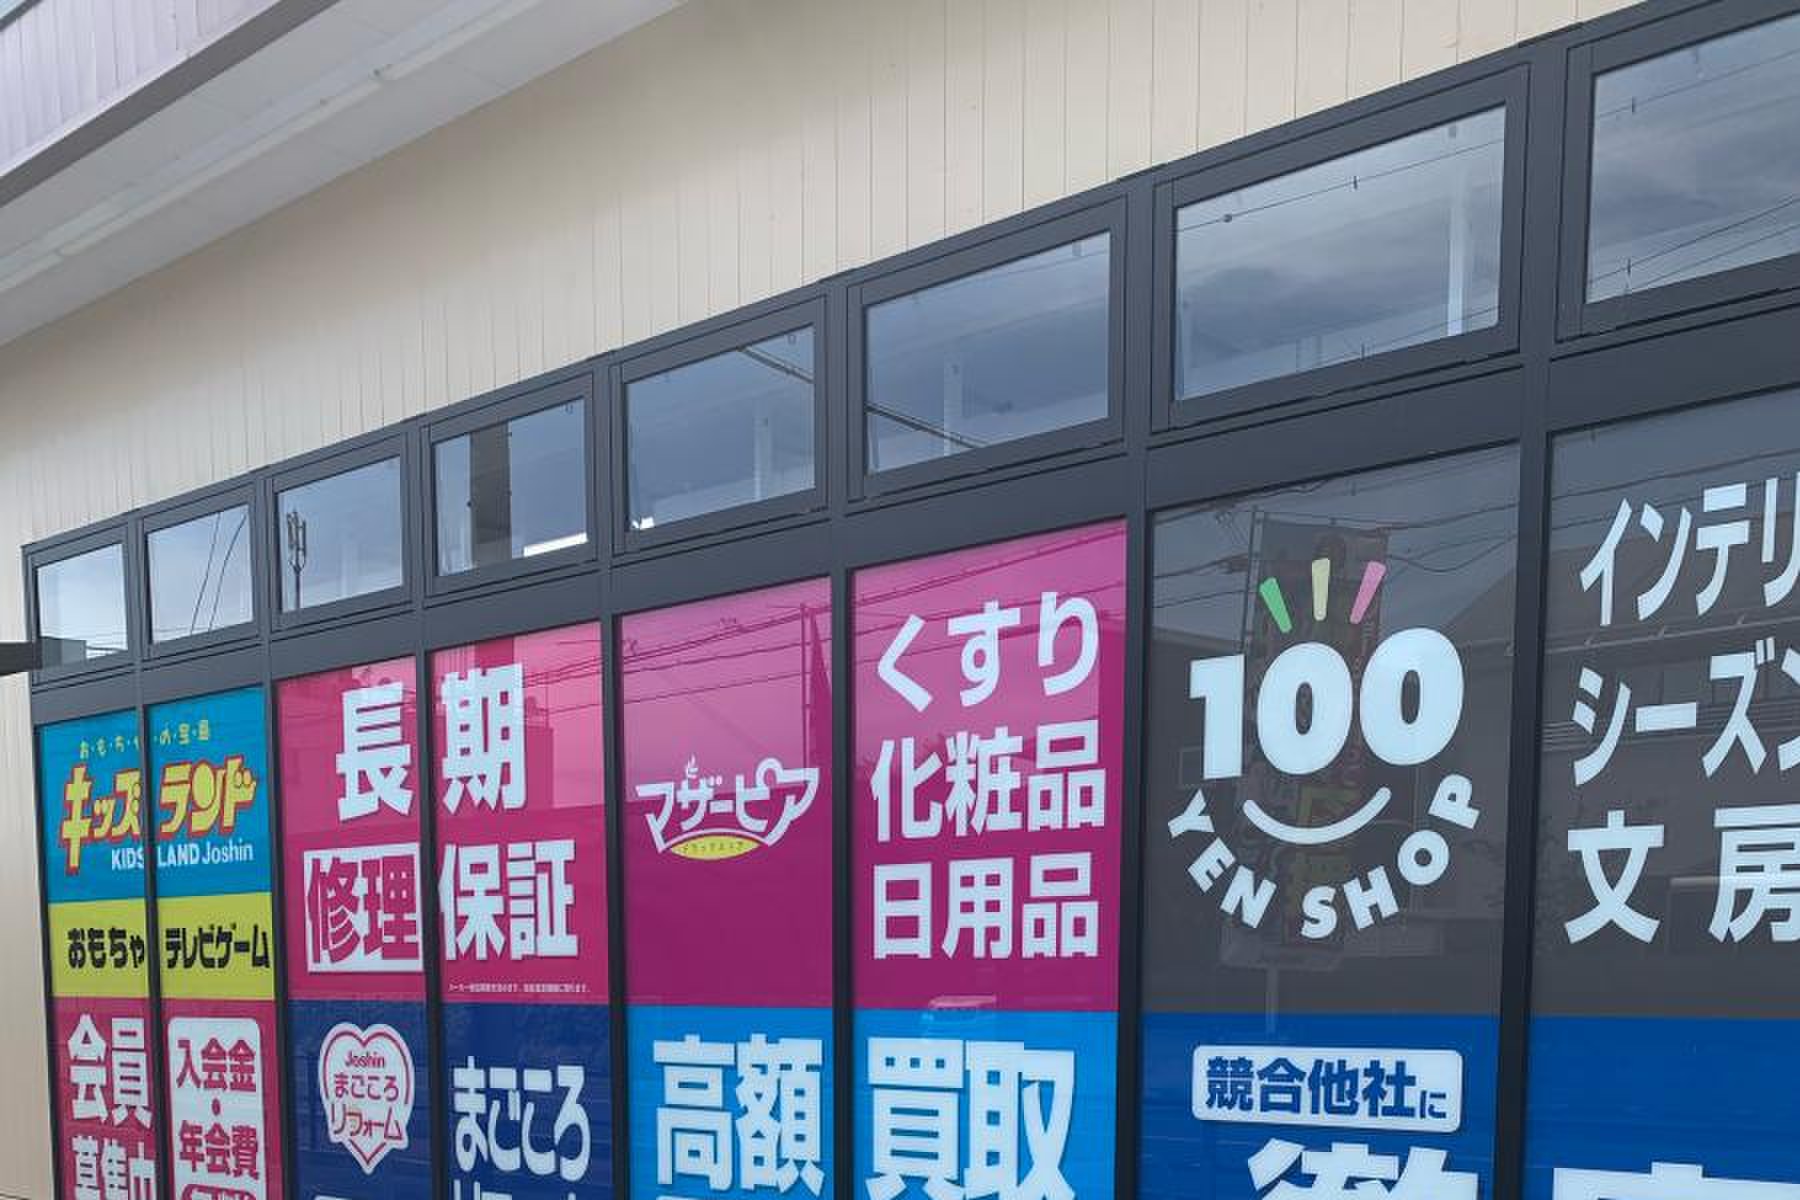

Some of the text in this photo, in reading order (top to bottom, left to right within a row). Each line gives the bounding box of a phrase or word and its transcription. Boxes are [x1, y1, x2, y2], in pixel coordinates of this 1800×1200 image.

[1580, 471, 1800, 626] インテリ
[877, 592, 1099, 712] くすり
[1190, 627, 1464, 780] 100
[870, 720, 1106, 842] 化粧品
[157, 844, 201, 868] LAND
[202, 838, 254, 866] Joshin
[1167, 773, 1480, 939] YEN SHOP
[307, 839, 579, 965] 修理 保証
[872, 852, 1099, 960] 日用品
[67, 927, 145, 968] おもちゃ
[165, 922, 271, 969] テレビゲーム
[68, 1013, 152, 1129] 会員
[176, 1037, 257, 1093] 入会金
[334, 1071, 400, 1101] まごころ
[345, 1050, 386, 1069] Joshin
[1205, 1056, 1448, 1121] 競合他社に
[179, 1119, 261, 1181] 年会費
[331, 1103, 403, 1141] リフォーム
[453, 1056, 591, 1182] まごころ
